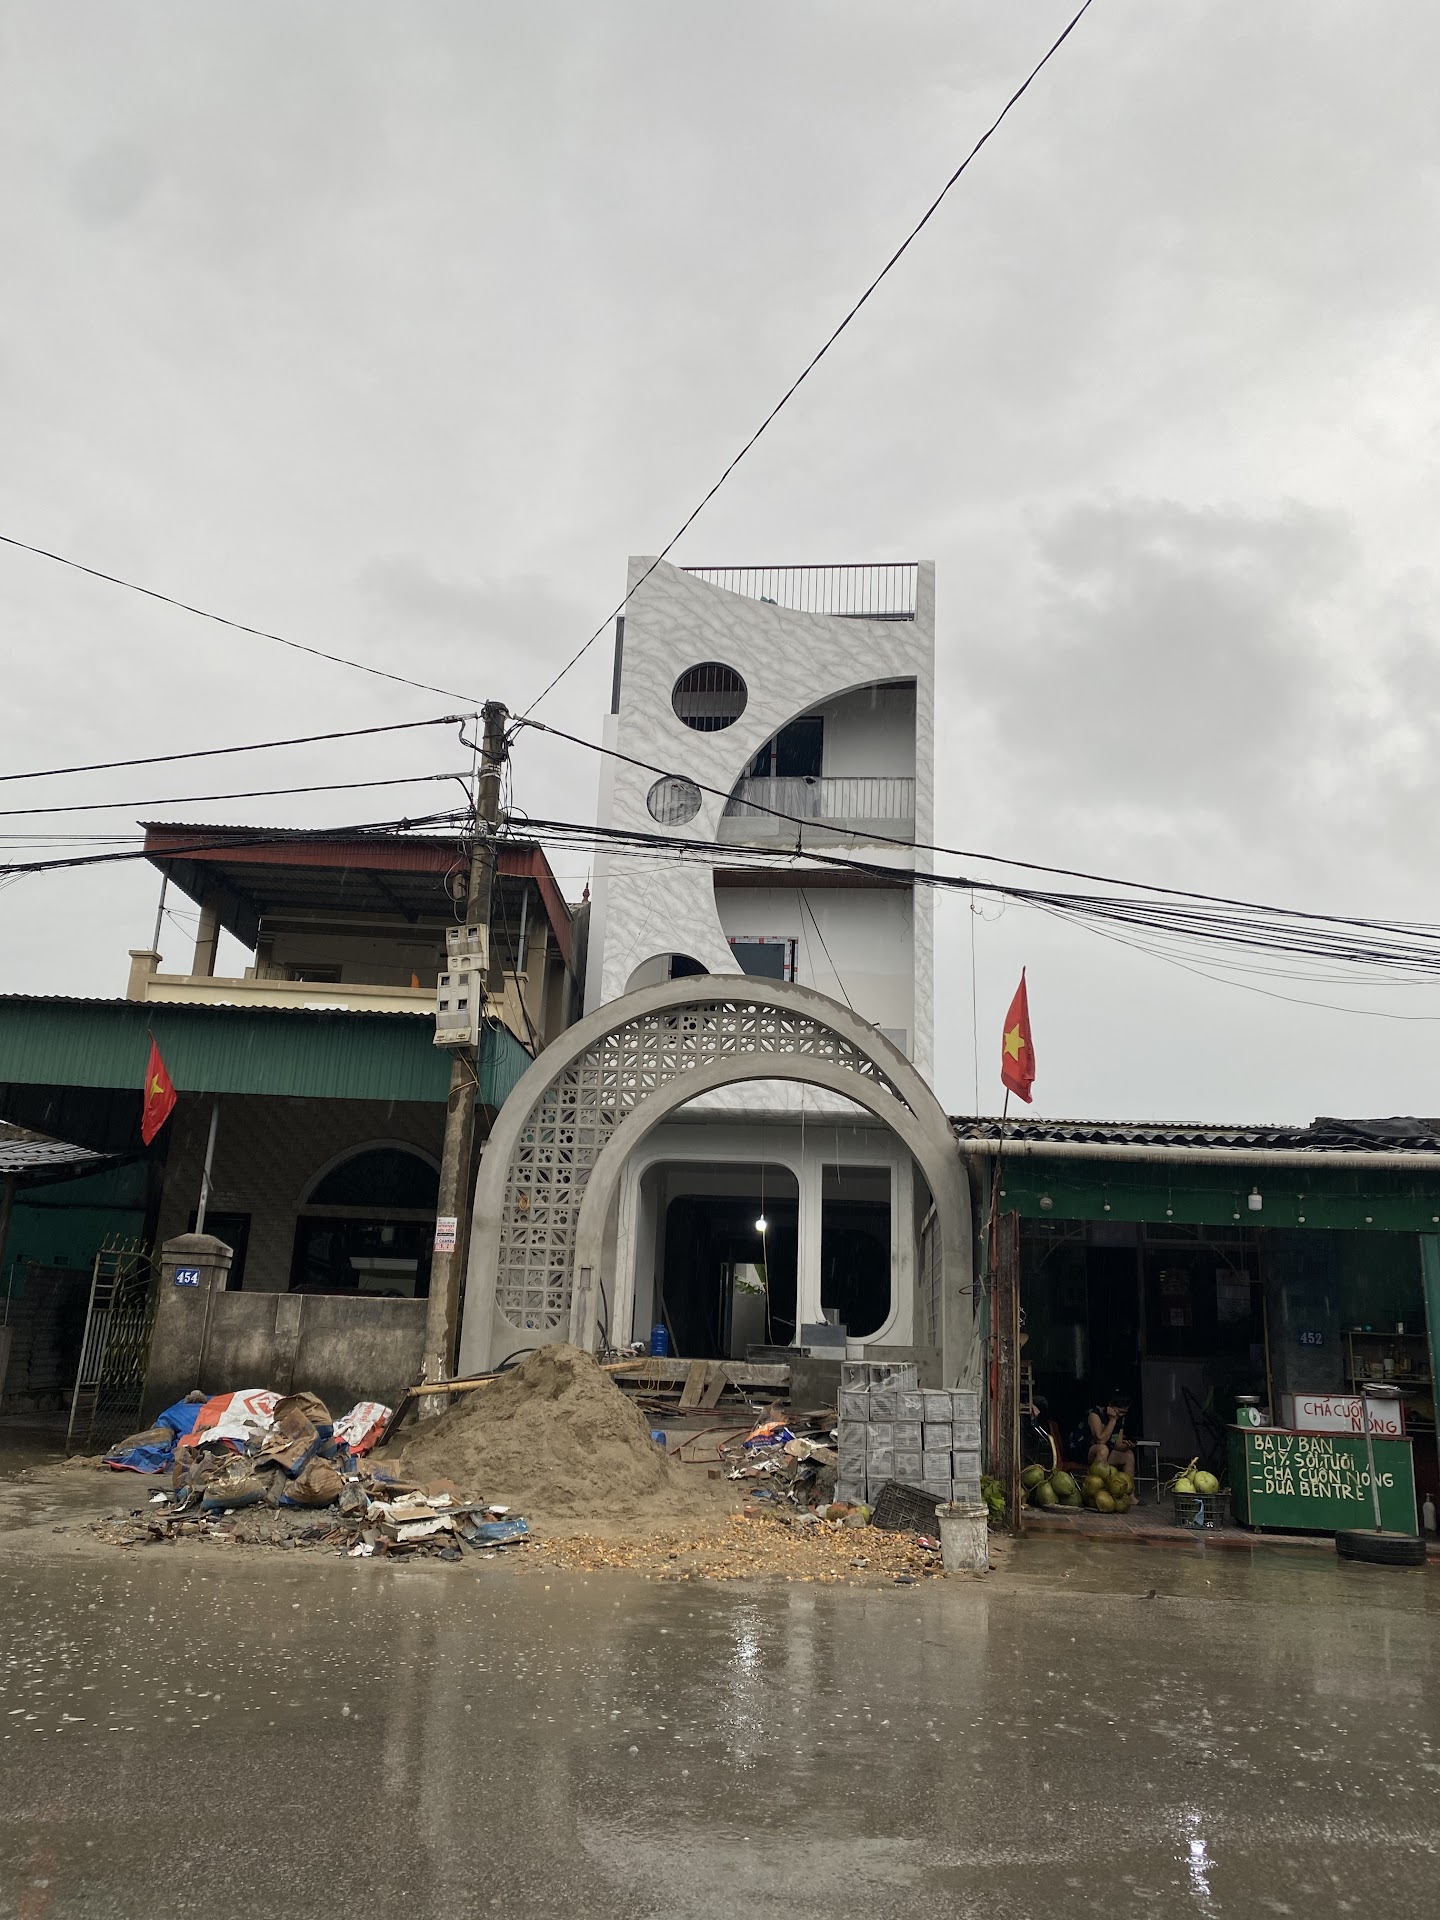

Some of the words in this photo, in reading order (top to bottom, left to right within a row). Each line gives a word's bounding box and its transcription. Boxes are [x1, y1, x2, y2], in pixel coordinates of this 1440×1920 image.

[177, 1272, 198, 1284] 454
[1300, 1332, 1323, 1345] 452
[1303, 1396, 1332, 1417] CHẢ
